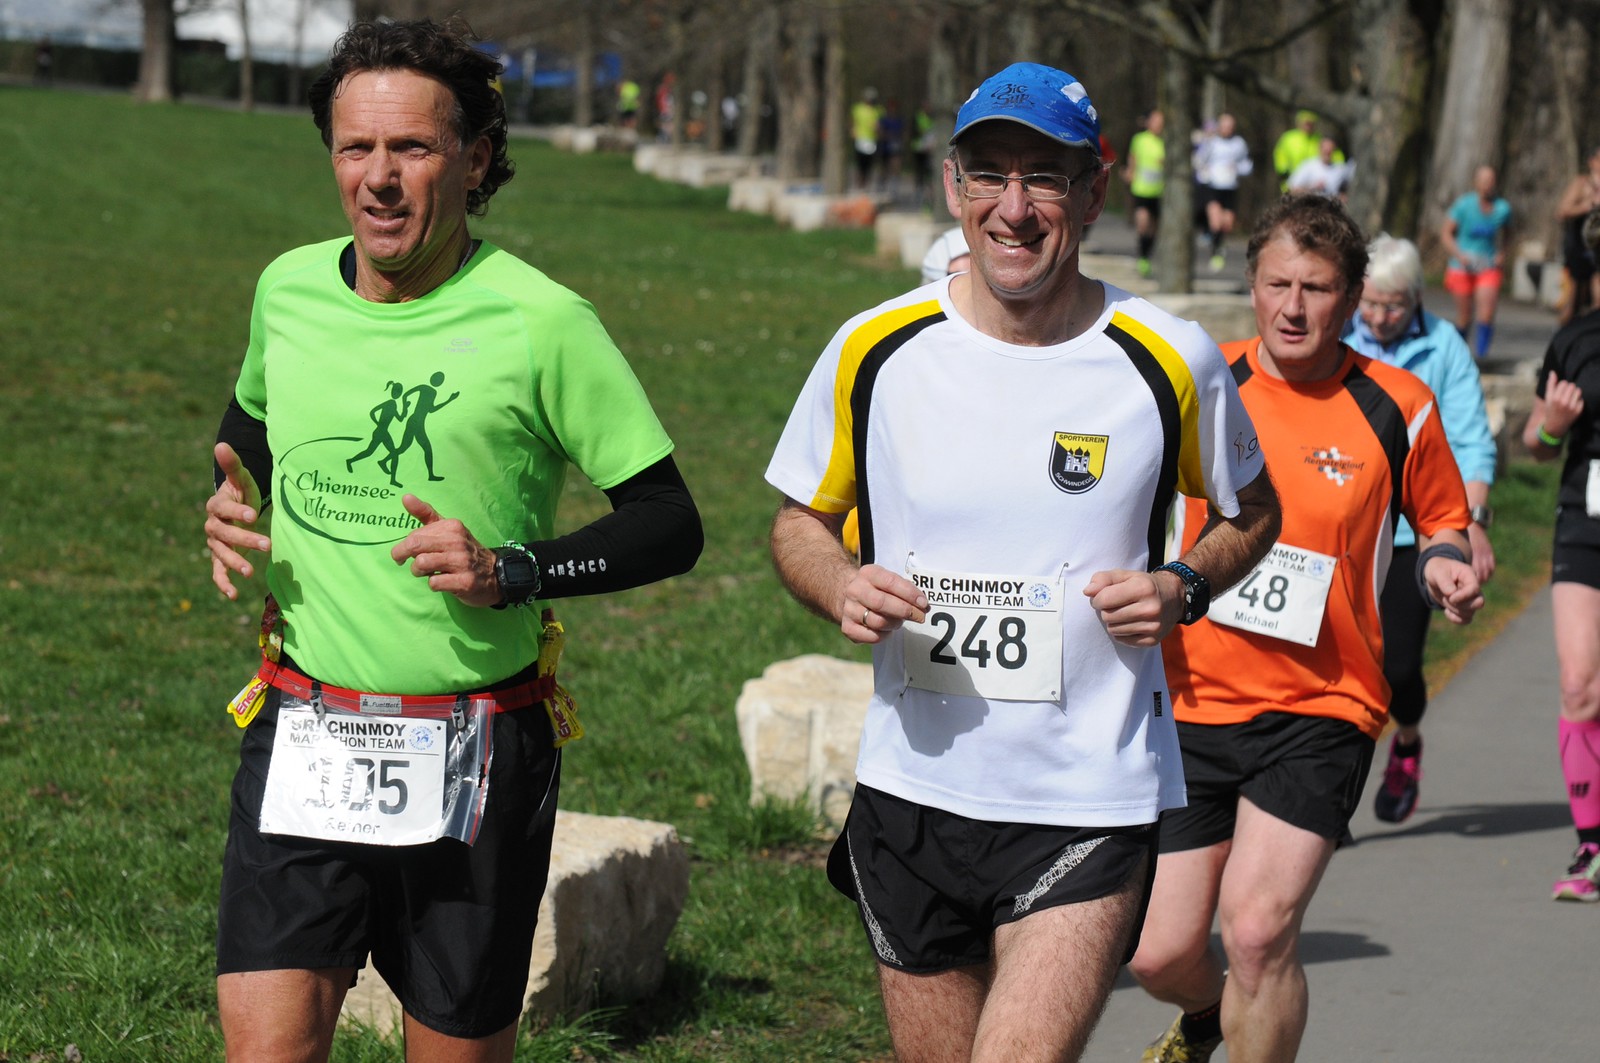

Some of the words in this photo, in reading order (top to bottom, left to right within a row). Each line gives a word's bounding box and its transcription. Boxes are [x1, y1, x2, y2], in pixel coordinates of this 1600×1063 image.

[1059, 434, 1105, 443] SPORTVEREIN
[296, 469, 396, 500] Chiemsee-
[304, 495, 422, 530] Ultramarath
[1271, 548, 1308, 563] NMOY
[1278, 560, 1306, 573] TEAM
[912, 574, 934, 589] SRI
[940, 577, 1025, 594] CHINMOY
[1238, 570, 1289, 613] 48
[926, 590, 981, 605] RATHON
[985, 595, 1024, 607] TEAM
[1234, 610, 1280, 630] Michael
[930, 611, 1028, 670] 248
[327, 720, 407, 737] CHINMOY
[370, 737, 406, 750] TEAM
